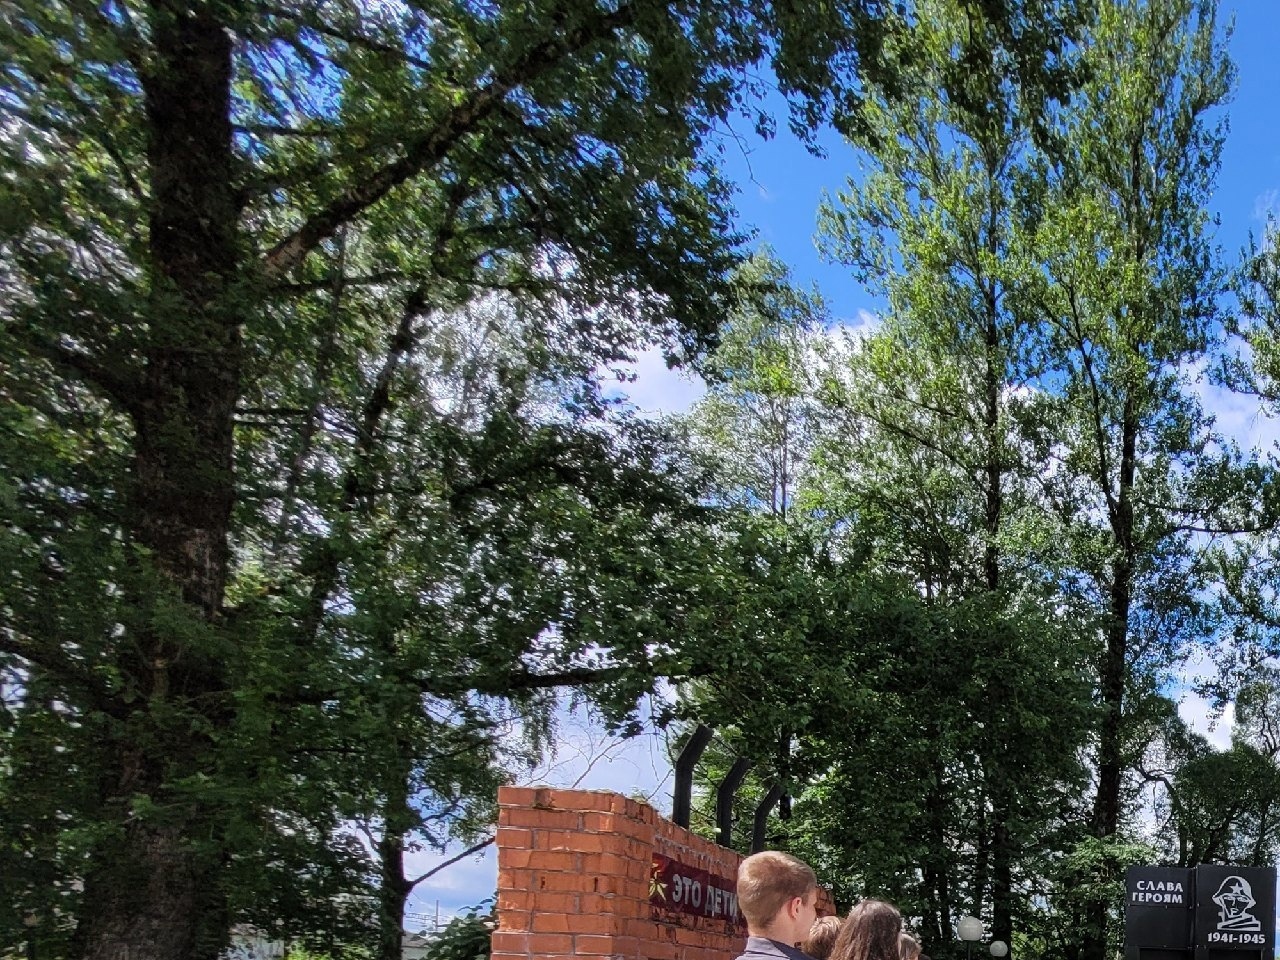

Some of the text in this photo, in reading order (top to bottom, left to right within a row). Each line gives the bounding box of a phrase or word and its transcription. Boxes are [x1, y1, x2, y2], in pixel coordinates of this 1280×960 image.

[672, 873, 701, 908] ЭТО
[1136, 880, 1184, 893] СЛАВА
[1132, 891, 1183, 904] ГЕРОЯМ
[1207, 932, 1266, 944] 1941-1945
